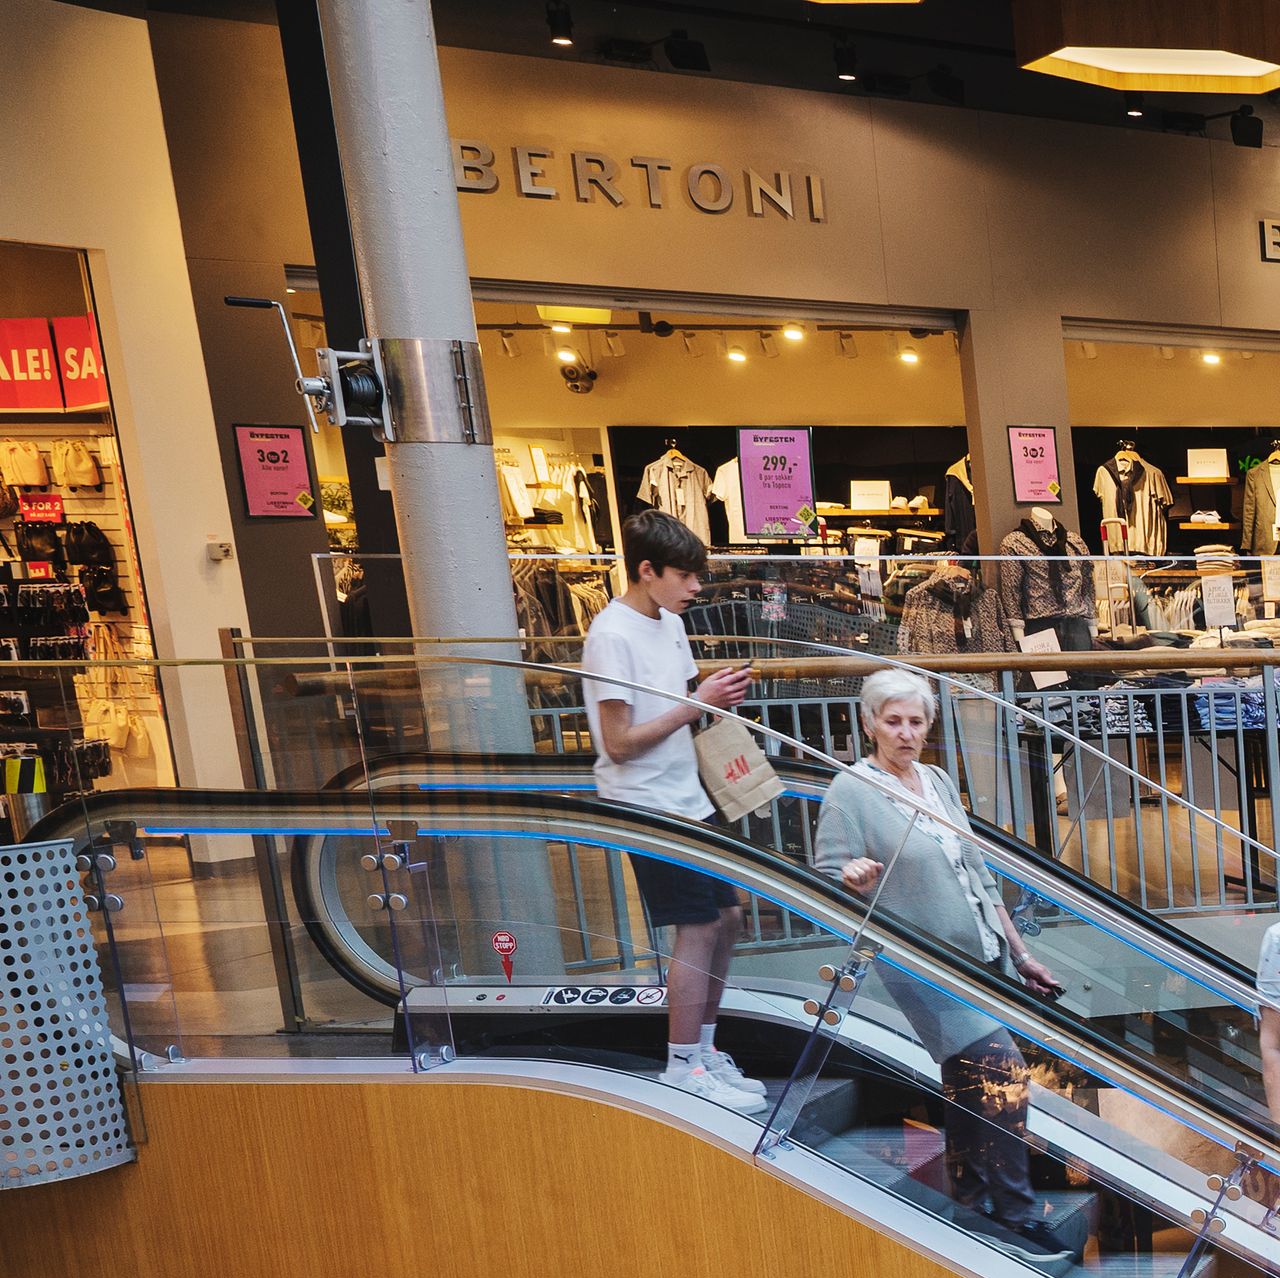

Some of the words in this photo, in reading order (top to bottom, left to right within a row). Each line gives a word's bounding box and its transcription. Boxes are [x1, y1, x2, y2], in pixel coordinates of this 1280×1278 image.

[451, 139, 826, 221] BERTONI
[0, 348, 51, 380] ALE!
[64, 347, 98, 380] SA
[257, 449, 265, 463] 3
[281, 450, 290, 463] 2
[1022, 446, 1029, 458] 3
[1039, 446, 1045, 458] 2
[762, 455, 798, 474] 299,-
[23, 502, 30, 511] 3
[32, 502, 52, 511] FOR
[54, 502, 61, 511] 2
[723, 754, 752, 784] H&M
[495, 941, 514, 950] STOPP
